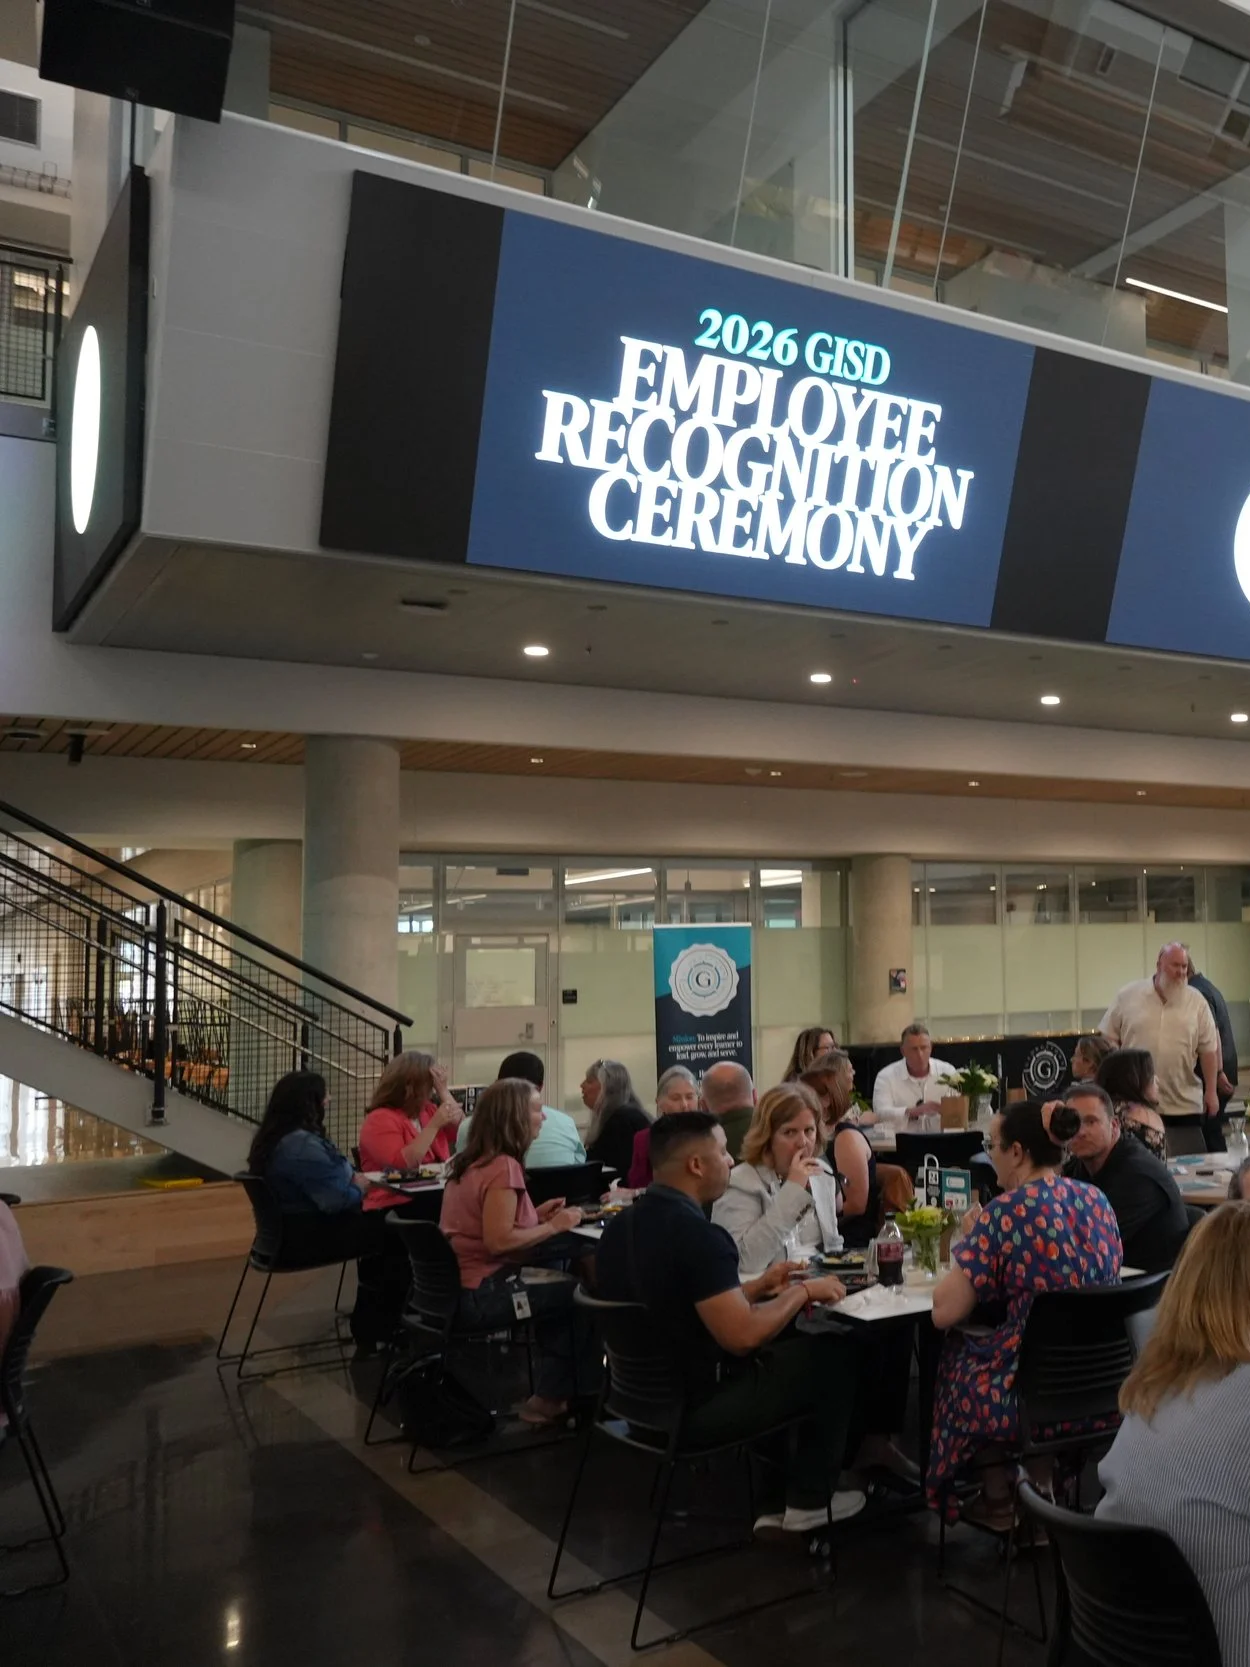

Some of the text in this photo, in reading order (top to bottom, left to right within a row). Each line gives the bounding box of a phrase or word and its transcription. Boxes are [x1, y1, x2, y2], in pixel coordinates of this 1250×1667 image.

[694, 309, 891, 386] 2026 GISD
[612, 335, 943, 465] EMPLOYEE
[534, 390, 975, 530] RECOGNITION
[588, 470, 937, 581] CEREMONY
[695, 970, 711, 988] G
[697, 1033, 705, 1042] To
[727, 1030, 739, 1040] and
[668, 1044, 697, 1053] empower
[697, 1042, 714, 1051] every
[735, 1040, 743, 1048] to
[707, 1050, 720, 1058] and
[1037, 1060, 1051, 1079] G
